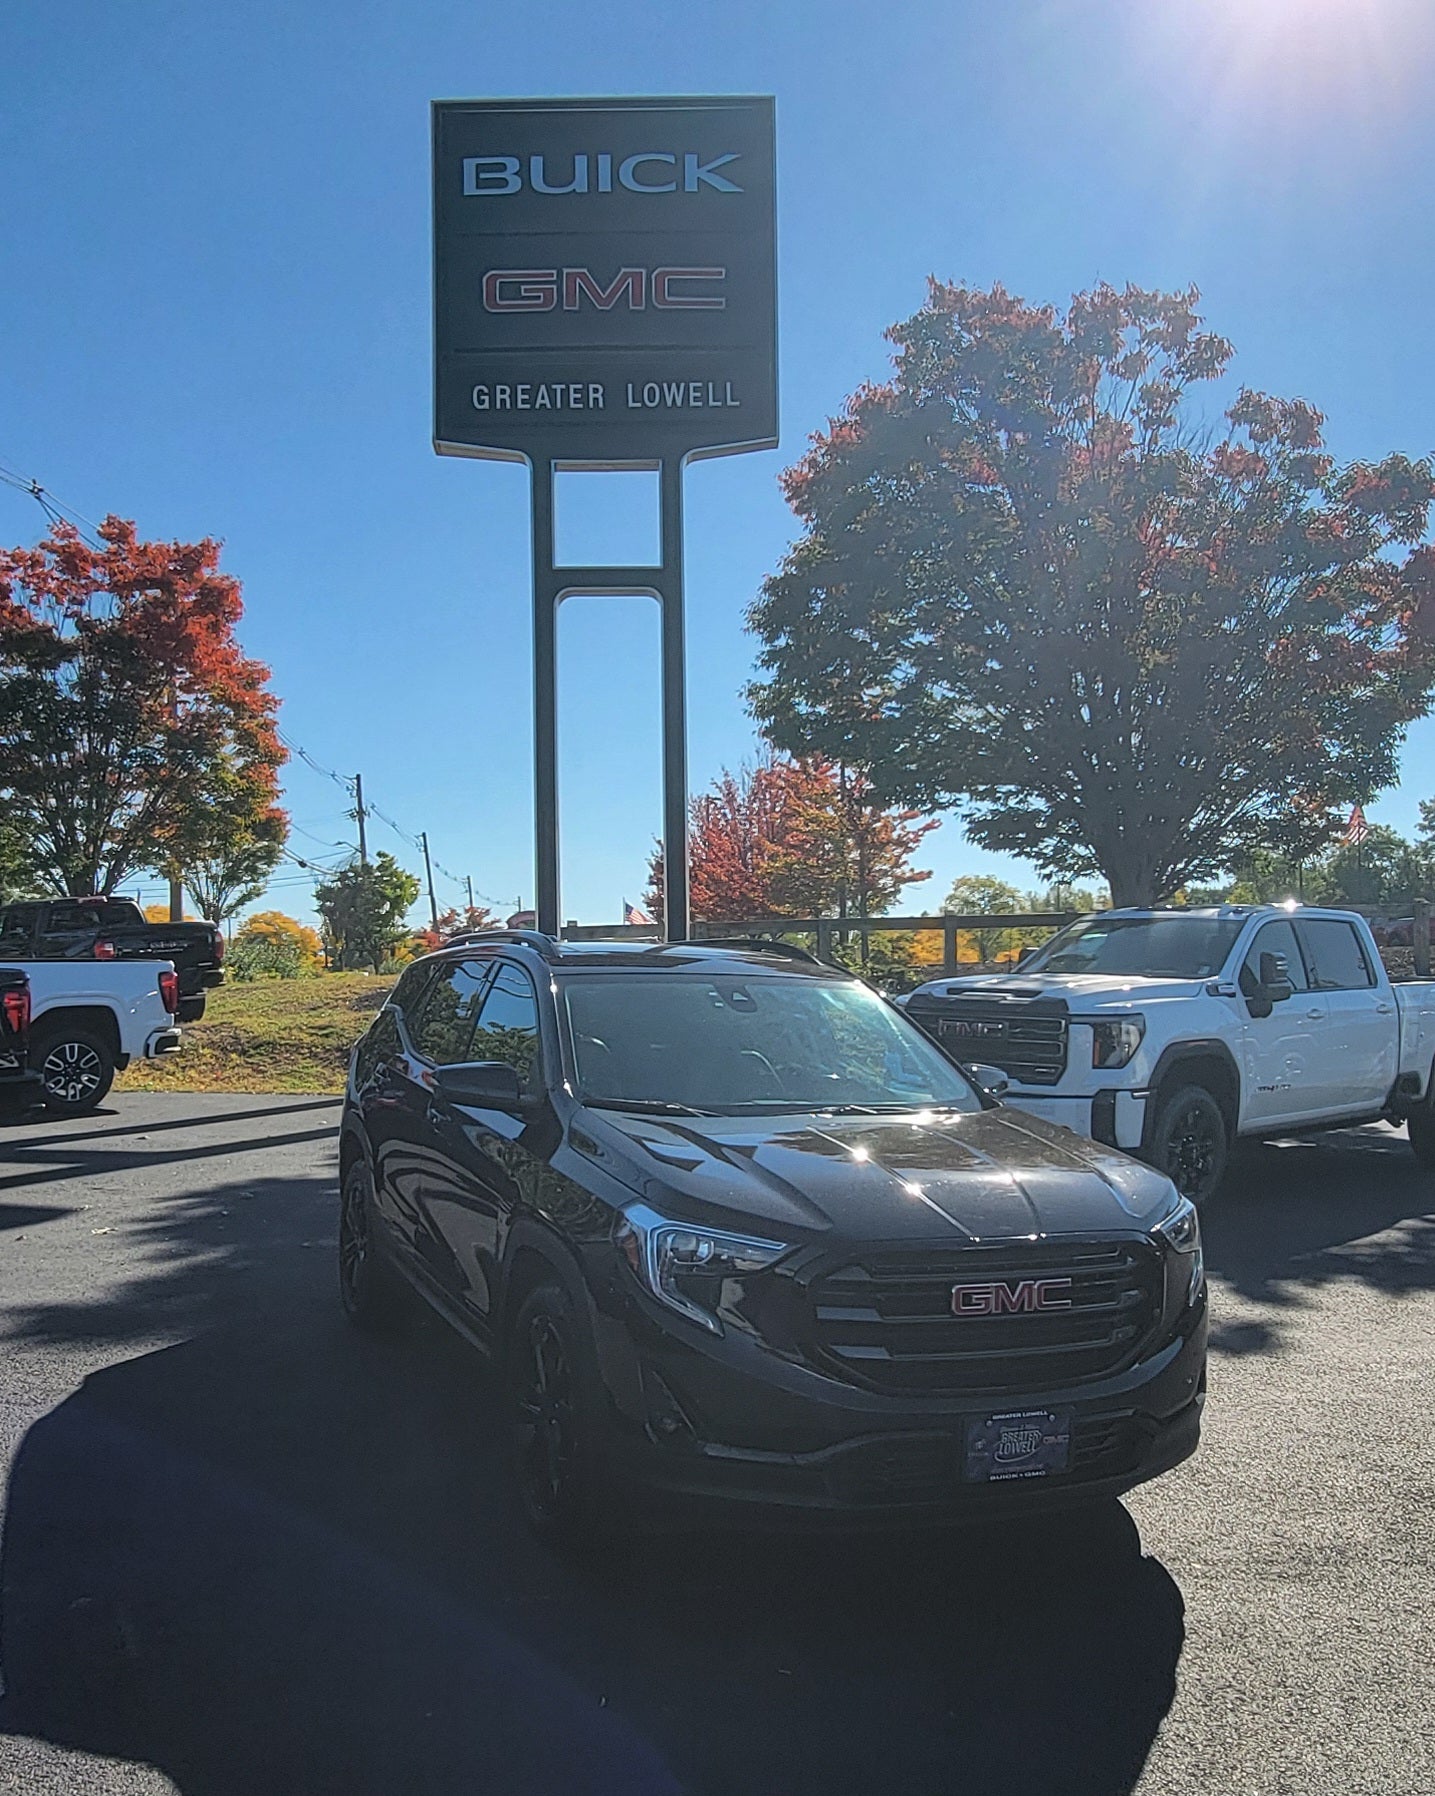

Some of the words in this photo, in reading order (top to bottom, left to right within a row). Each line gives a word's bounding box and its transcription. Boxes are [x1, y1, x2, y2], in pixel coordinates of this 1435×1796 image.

[463, 153, 744, 196] BUICK
[482, 267, 727, 313] GMC
[472, 384, 605, 410] GREATER
[627, 382, 741, 408] LOWELL
[952, 1278, 1072, 1315] GMC
[993, 1412, 1021, 1420] GREATER
[999, 1440, 1037, 1455] LOWELL
[1001, 1430, 1041, 1443] GREATER
